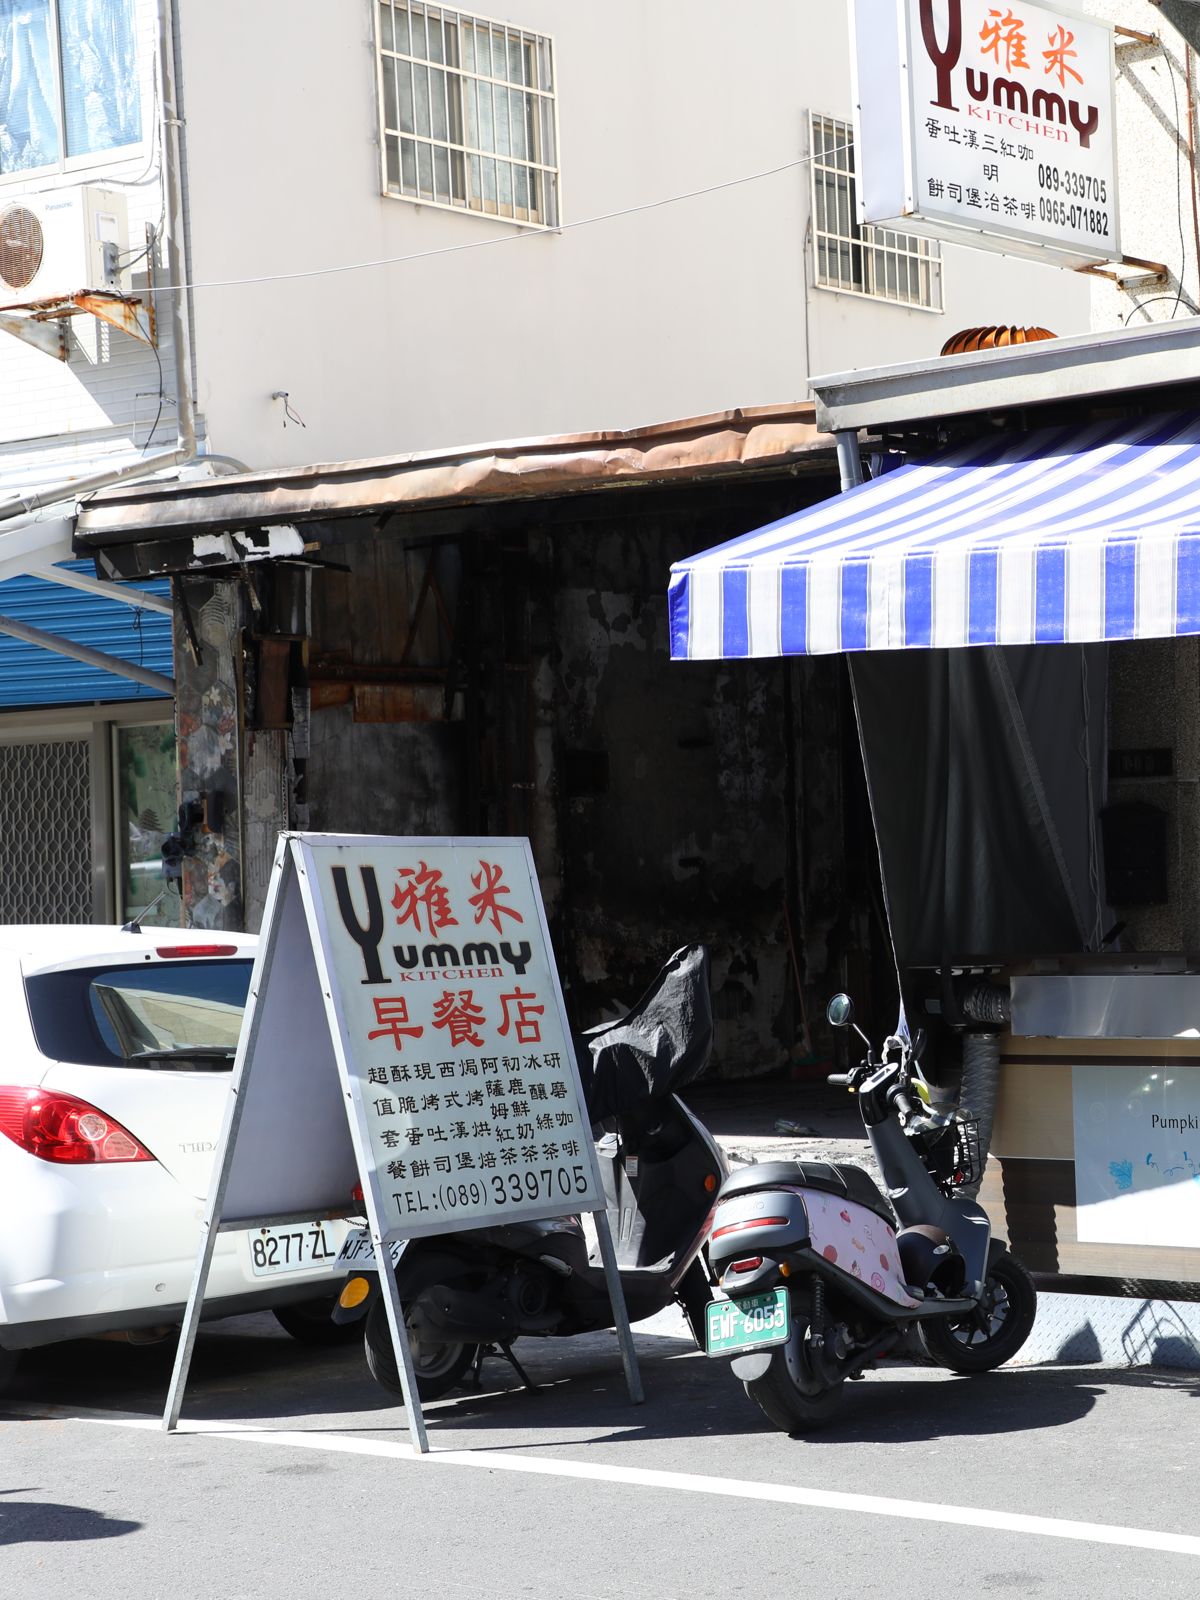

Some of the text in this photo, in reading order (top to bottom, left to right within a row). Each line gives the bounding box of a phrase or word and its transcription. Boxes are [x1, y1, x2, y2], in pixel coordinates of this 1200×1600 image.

[919, 0, 1099, 149] Yummy
[979, 8, 1084, 88] 雅米
[1038, 163, 1107, 204] 089-339705
[1039, 197, 1109, 236] 0965-071882
[330, 866, 532, 984] Yummy
[391, 860, 524, 938] 雅米
[368, 986, 545, 1051] 早餐店
